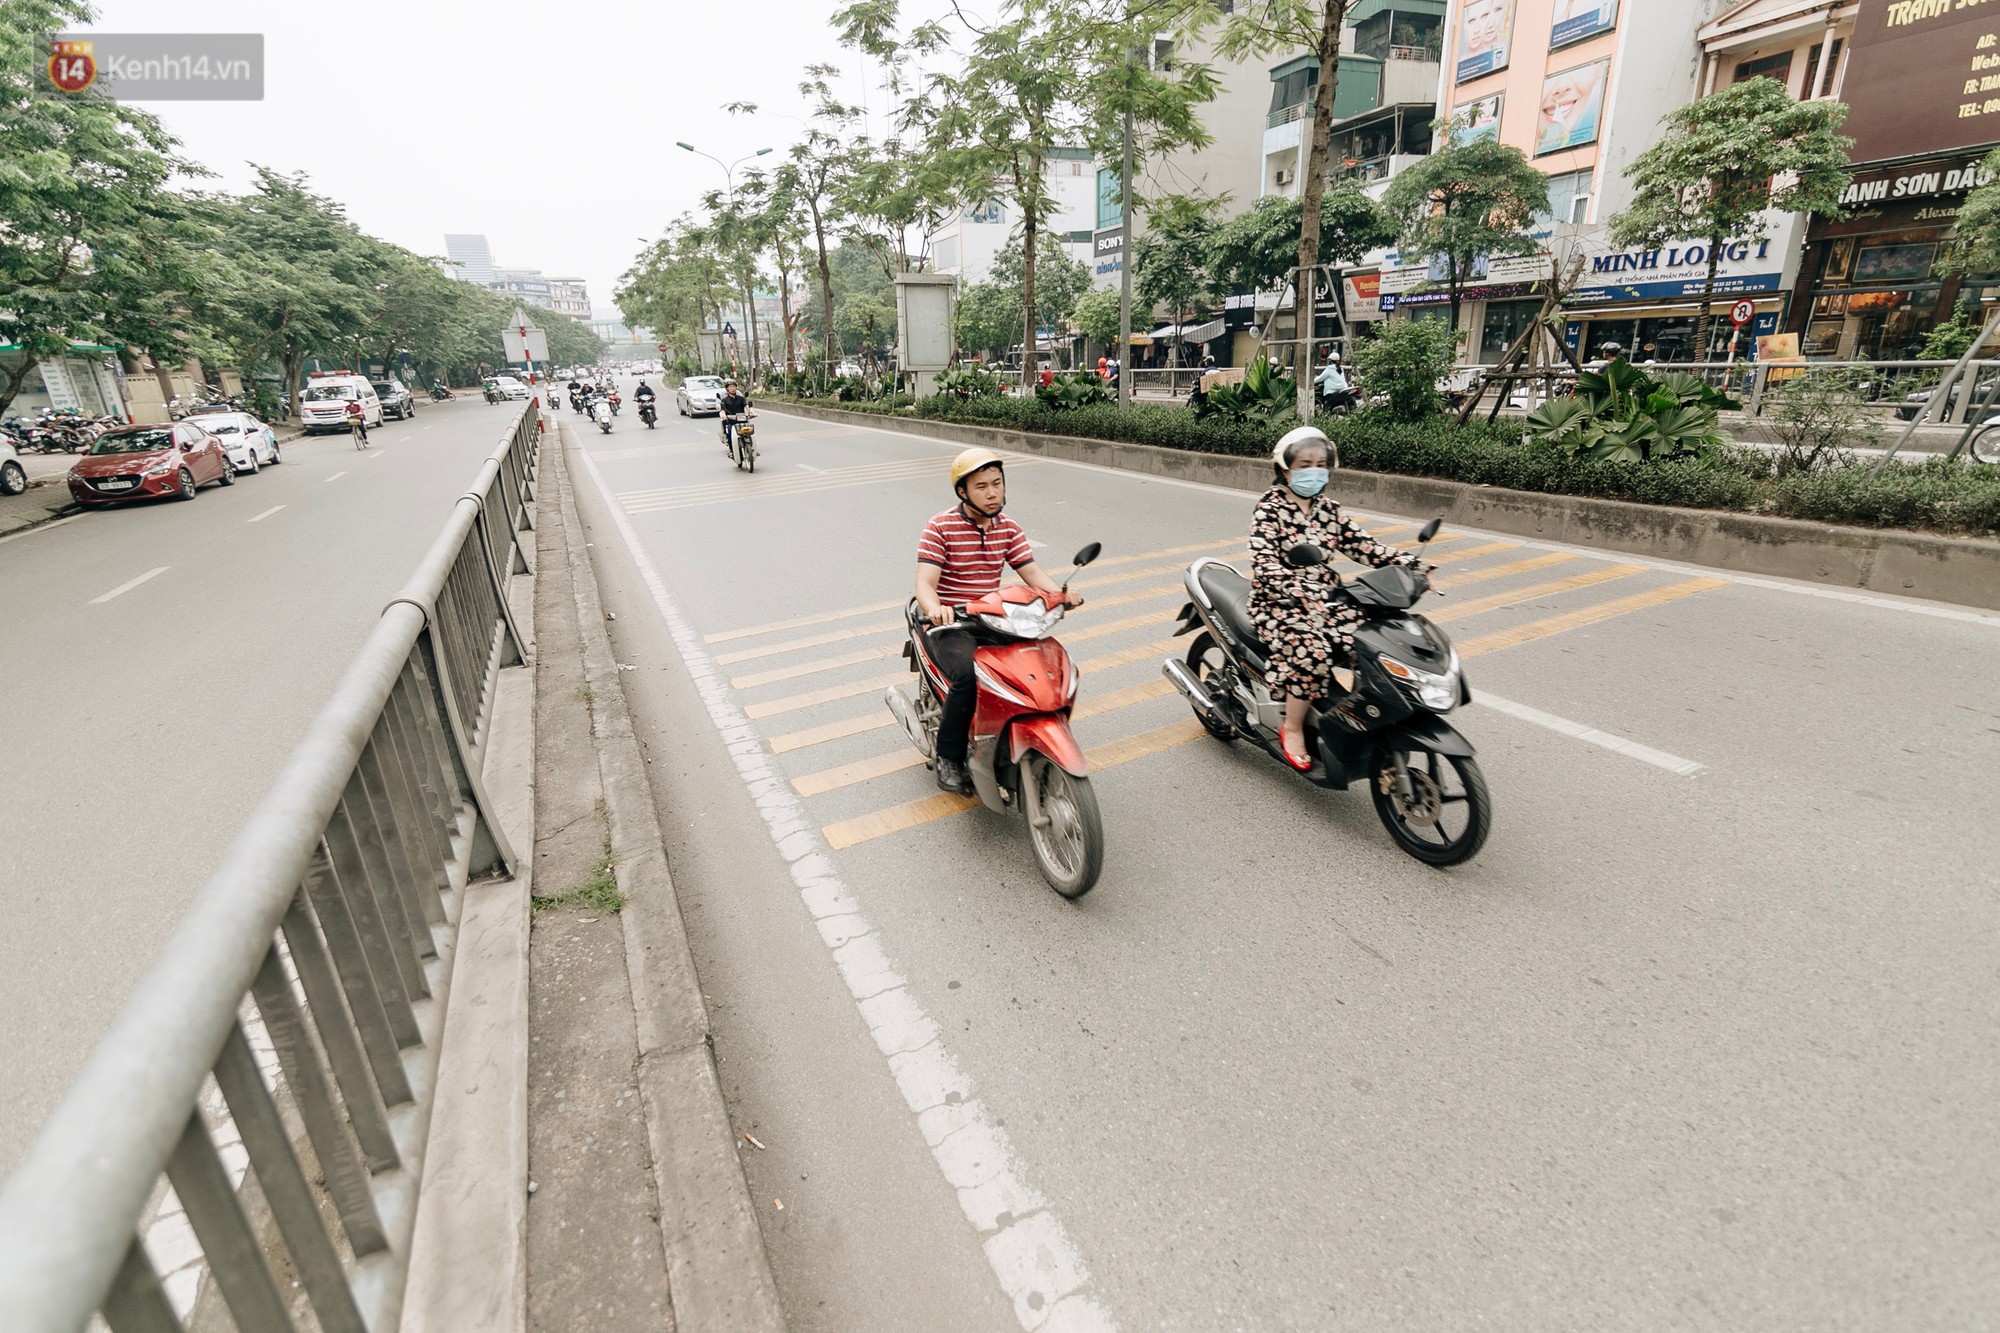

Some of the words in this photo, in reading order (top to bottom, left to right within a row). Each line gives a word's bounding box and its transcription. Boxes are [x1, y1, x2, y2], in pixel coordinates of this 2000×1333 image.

[1098, 235, 1124, 250] SONY
[1592, 249, 1659, 275] MINH
[1666, 240, 1749, 267] LONG
